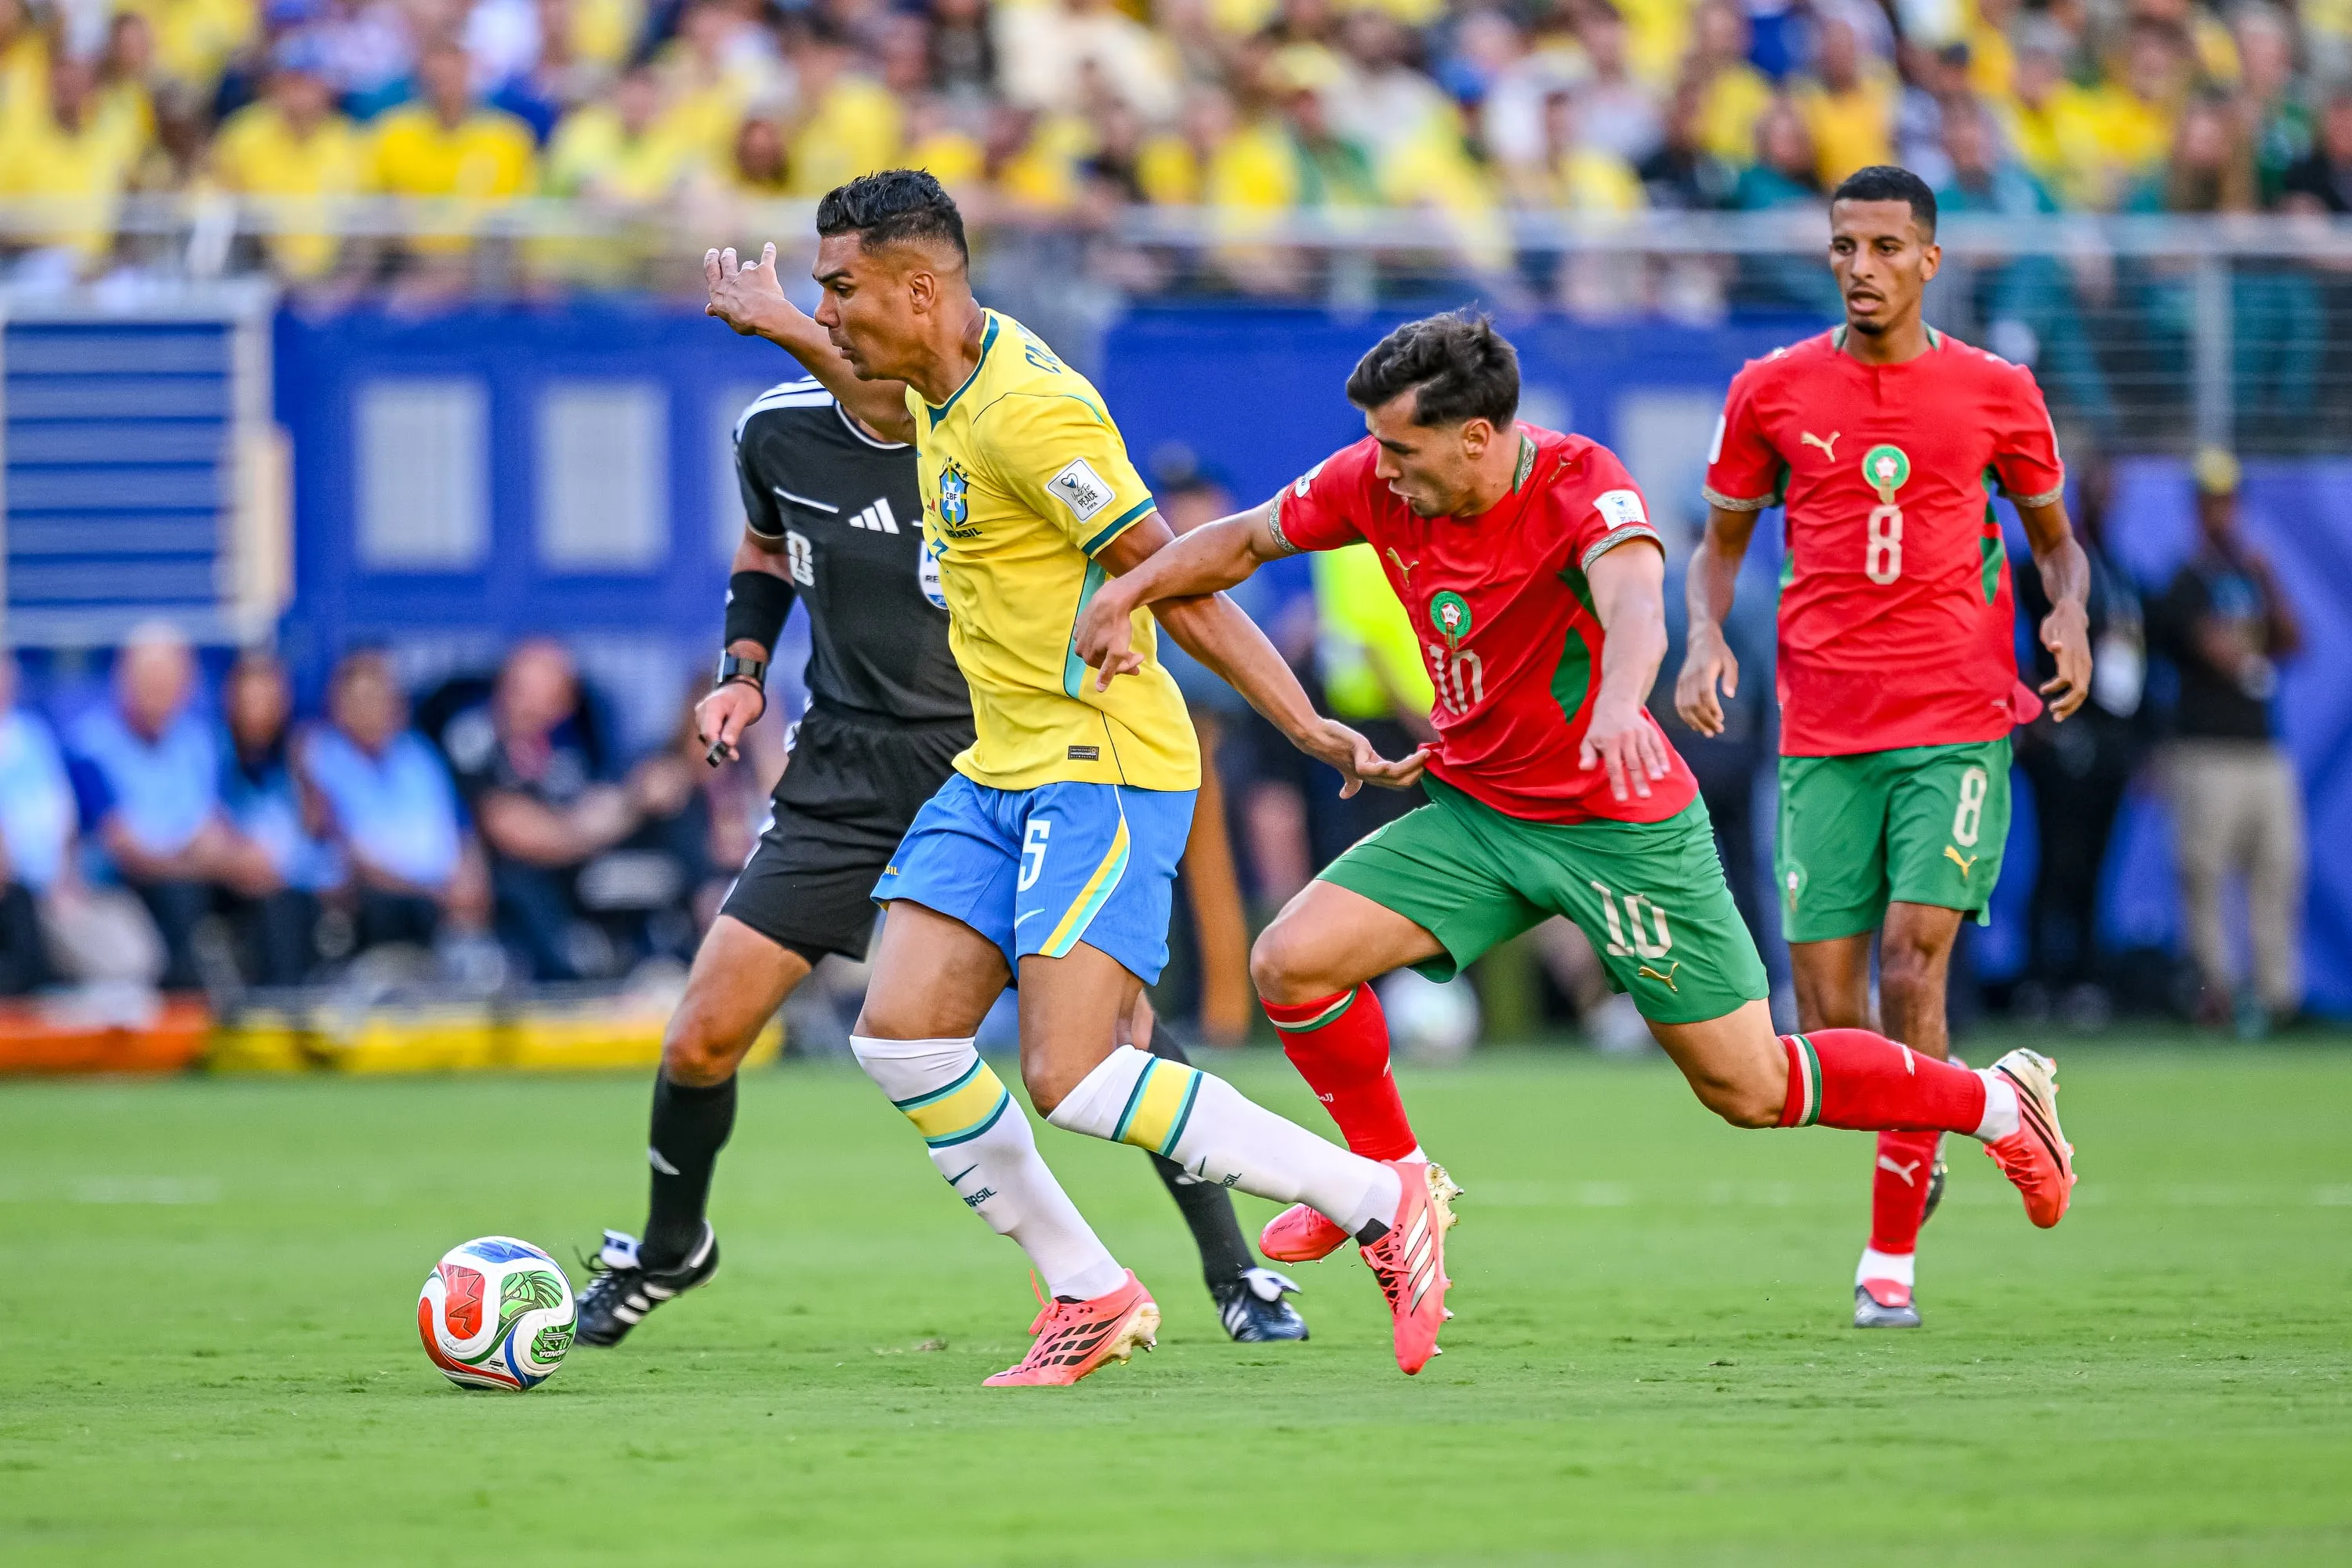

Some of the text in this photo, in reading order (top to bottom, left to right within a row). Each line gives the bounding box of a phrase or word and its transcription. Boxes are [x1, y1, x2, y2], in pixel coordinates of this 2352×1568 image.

[946, 492, 957, 500] CBF
[1078, 490, 1098, 508] PEACE
[1087, 502, 1098, 511] FIFA
[1865, 504, 1904, 586] 8
[1428, 644, 1483, 715] 10
[1952, 767, 1988, 848] 8
[1018, 819, 1051, 892] 5
[1591, 880, 1672, 959] 10
[963, 1187, 997, 1207] RASIL
